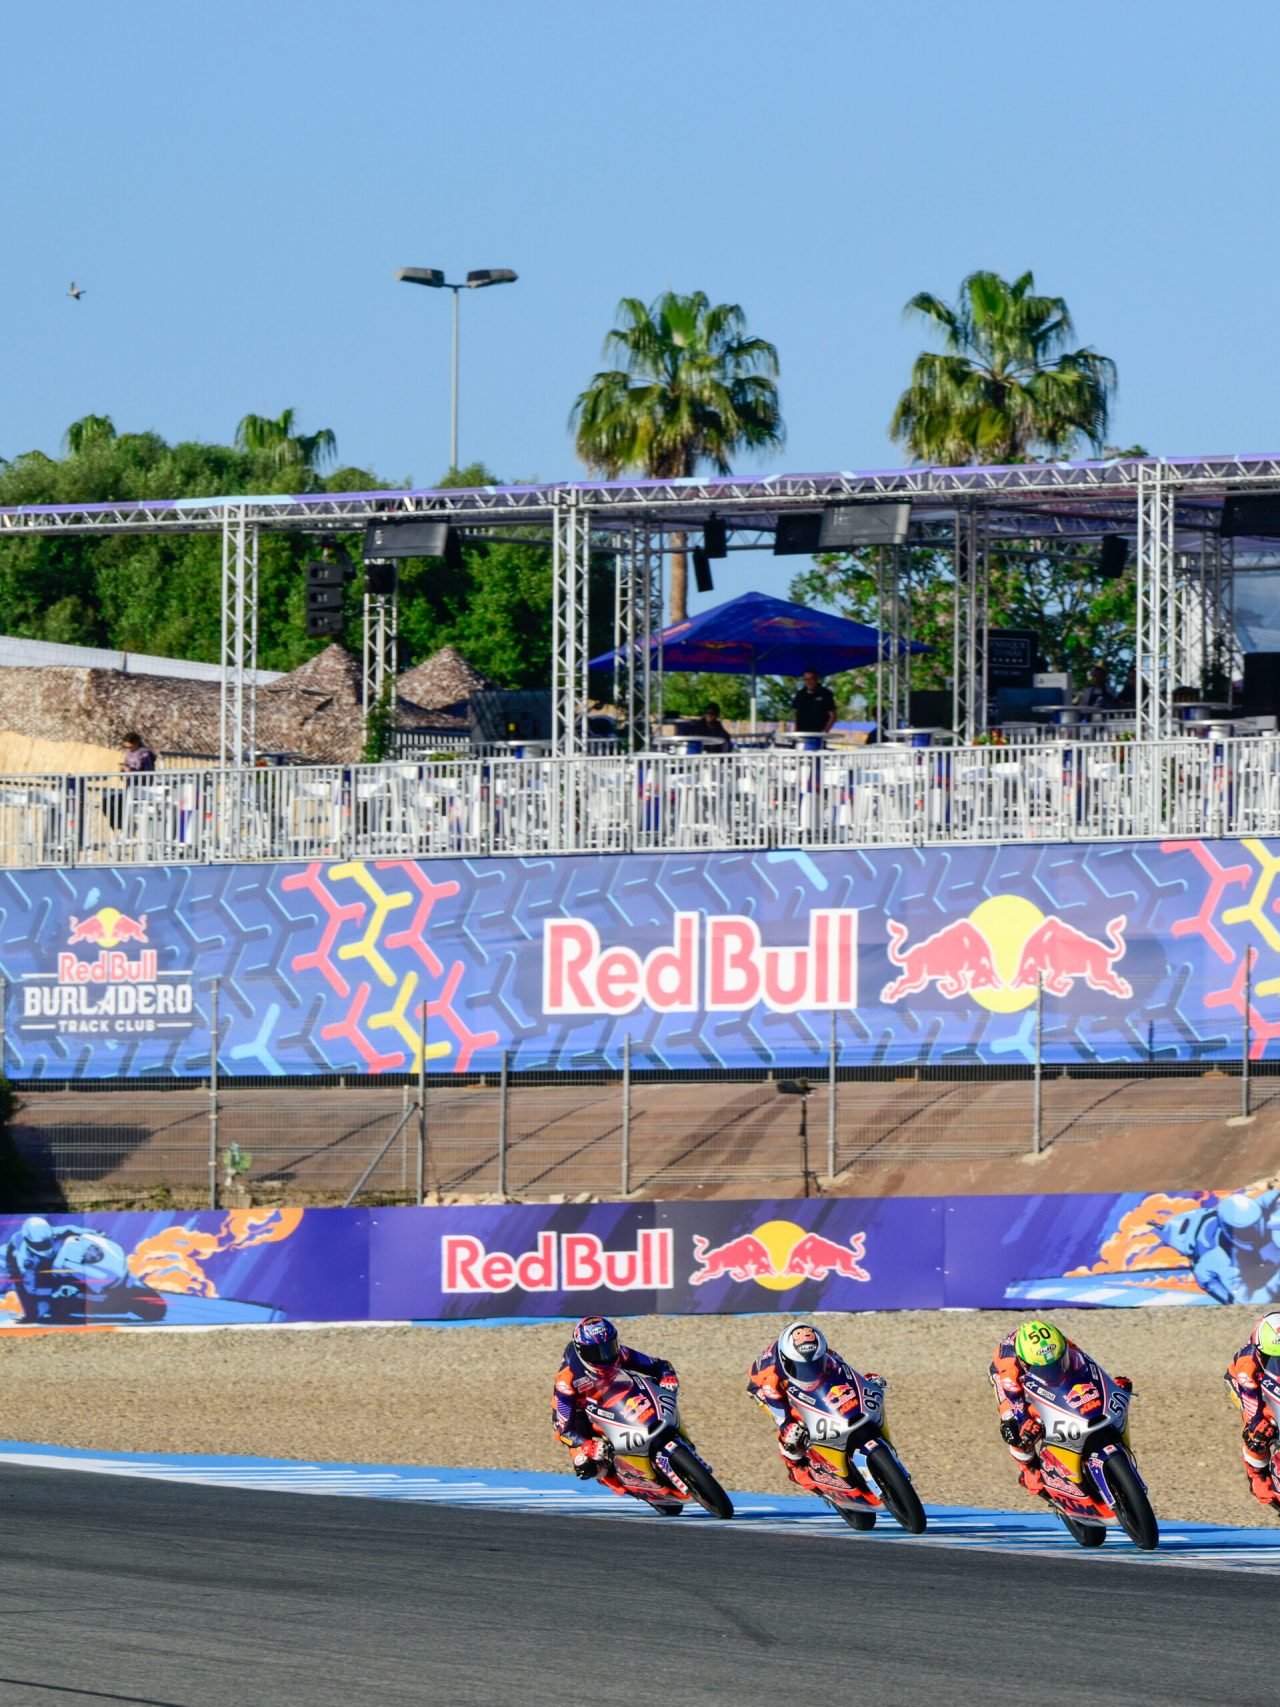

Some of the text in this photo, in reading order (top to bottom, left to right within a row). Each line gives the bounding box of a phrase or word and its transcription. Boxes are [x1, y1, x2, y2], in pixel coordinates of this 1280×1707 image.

[58, 949, 157, 984] Red Bull
[542, 908, 859, 1015] Red Bull
[23, 984, 193, 1016] BURLADERO
[58, 1020, 156, 1033] TRACK CLUB
[441, 1228, 674, 1293] Red Bull
[792, 1328, 815, 1345] 95
[1028, 1328, 1051, 1344] 50
[864, 1388, 882, 1410] 95
[1109, 1392, 1129, 1418] 50
[816, 1418, 841, 1440] 95
[1052, 1420, 1081, 1443] 50
[620, 1431, 646, 1452] 70
